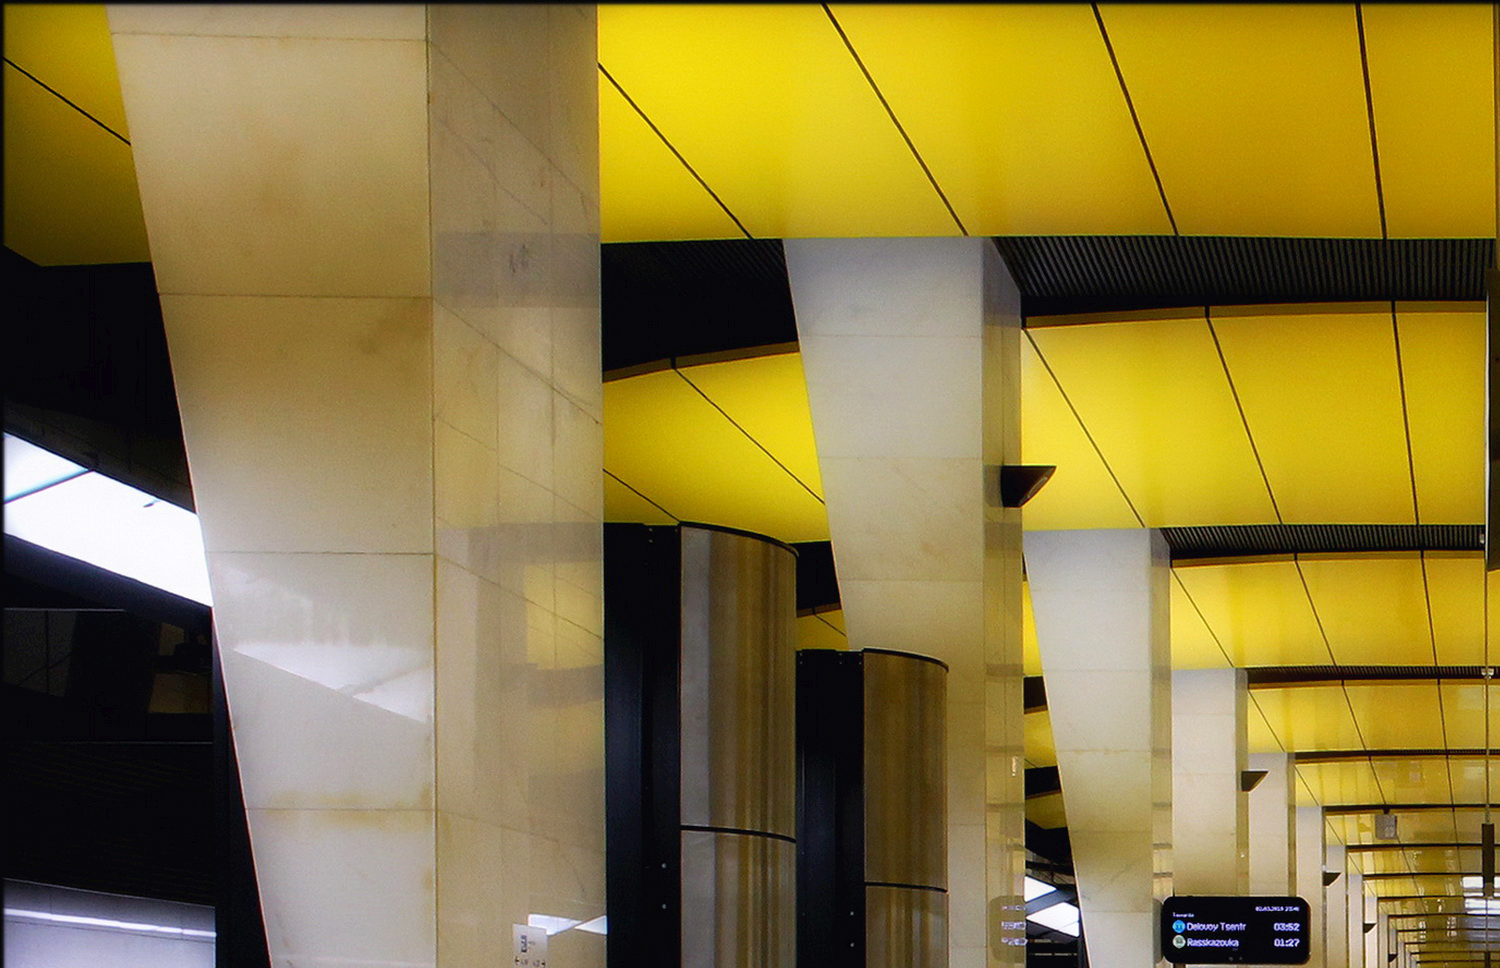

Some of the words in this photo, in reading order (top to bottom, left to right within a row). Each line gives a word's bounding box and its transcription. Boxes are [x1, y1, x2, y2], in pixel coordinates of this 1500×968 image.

[1186, 922, 1219, 932] Delovoy
[1220, 922, 1247, 931] Tsentr
[1274, 922, 1300, 932] 03:52
[1187, 938, 1240, 948] Rasskazovka
[1274, 938, 1300, 948] 01:27
